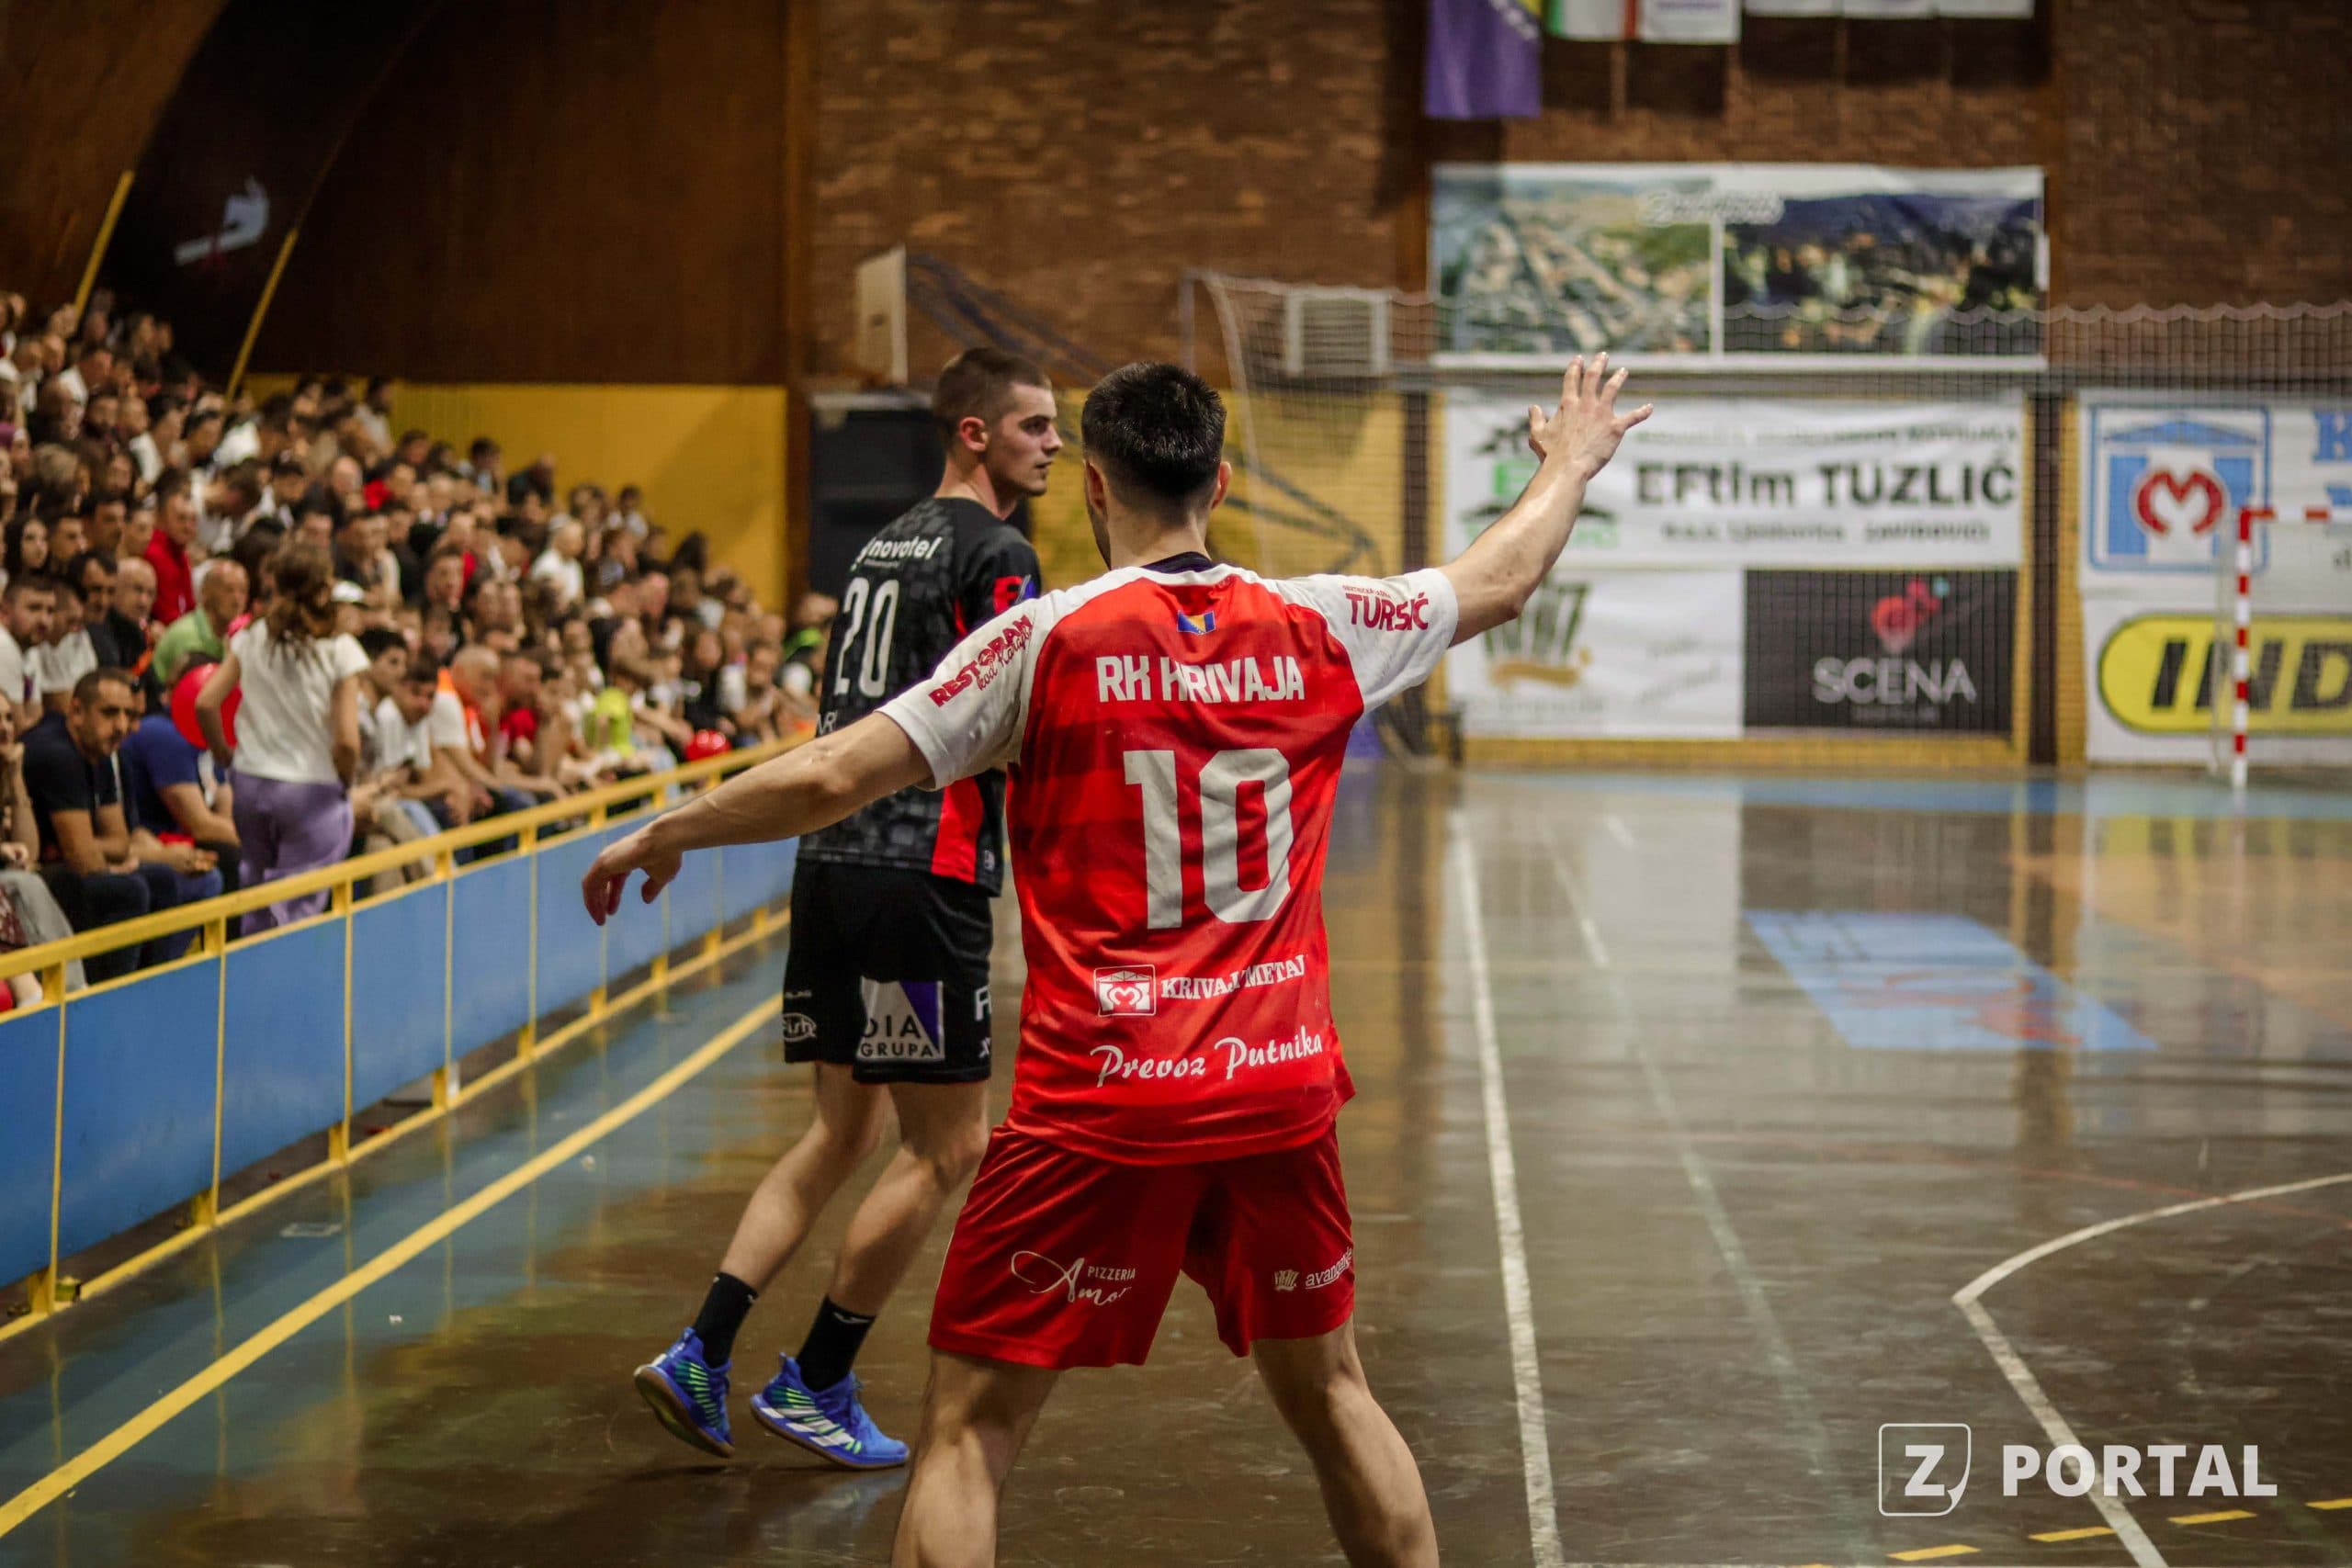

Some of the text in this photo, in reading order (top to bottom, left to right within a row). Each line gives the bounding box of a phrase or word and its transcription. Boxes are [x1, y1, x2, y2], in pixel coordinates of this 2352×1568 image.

[1818, 449, 2016, 507] TUZLIĆ
[1345, 592, 1429, 632] TURSIĆ
[833, 577, 899, 697] 20
[928, 615, 1034, 707] RESTORAN
[1096, 655, 1306, 704] RK KRIVAJA
[1813, 657, 1977, 705] SCENA
[1123, 748, 1293, 929] 10
[1161, 970, 1246, 1000] KRIVAJ
[861, 1043, 933, 1057] GRUPA
[1090, 1025, 1323, 1089] Prevoz Putnika
[1087, 1266, 1136, 1281] PIZZERIA
